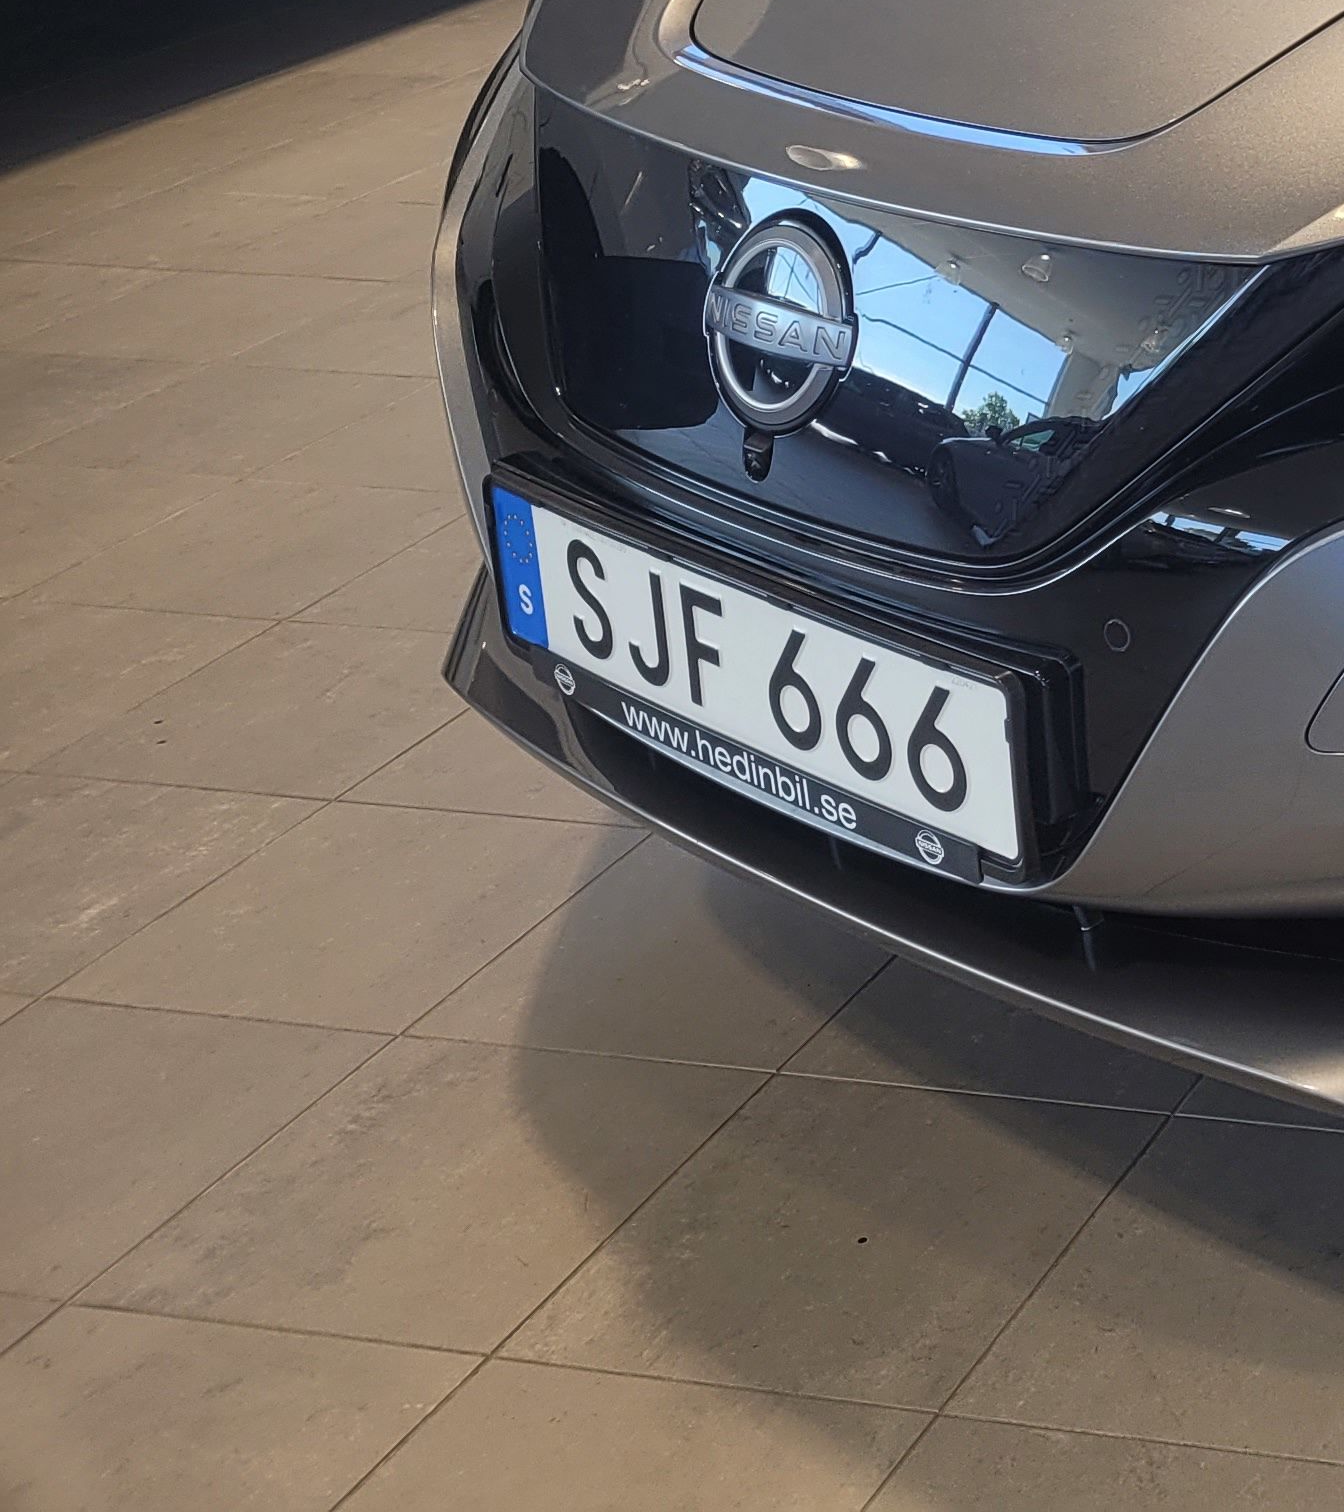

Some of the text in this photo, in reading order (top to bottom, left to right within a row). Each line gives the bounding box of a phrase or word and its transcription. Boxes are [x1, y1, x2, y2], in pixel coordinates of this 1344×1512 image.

[708, 291, 846, 360] NISSAN
[518, 584, 534, 616] S
[567, 539, 967, 812] SJF 666
[621, 701, 857, 830] www.hedinbil.se
